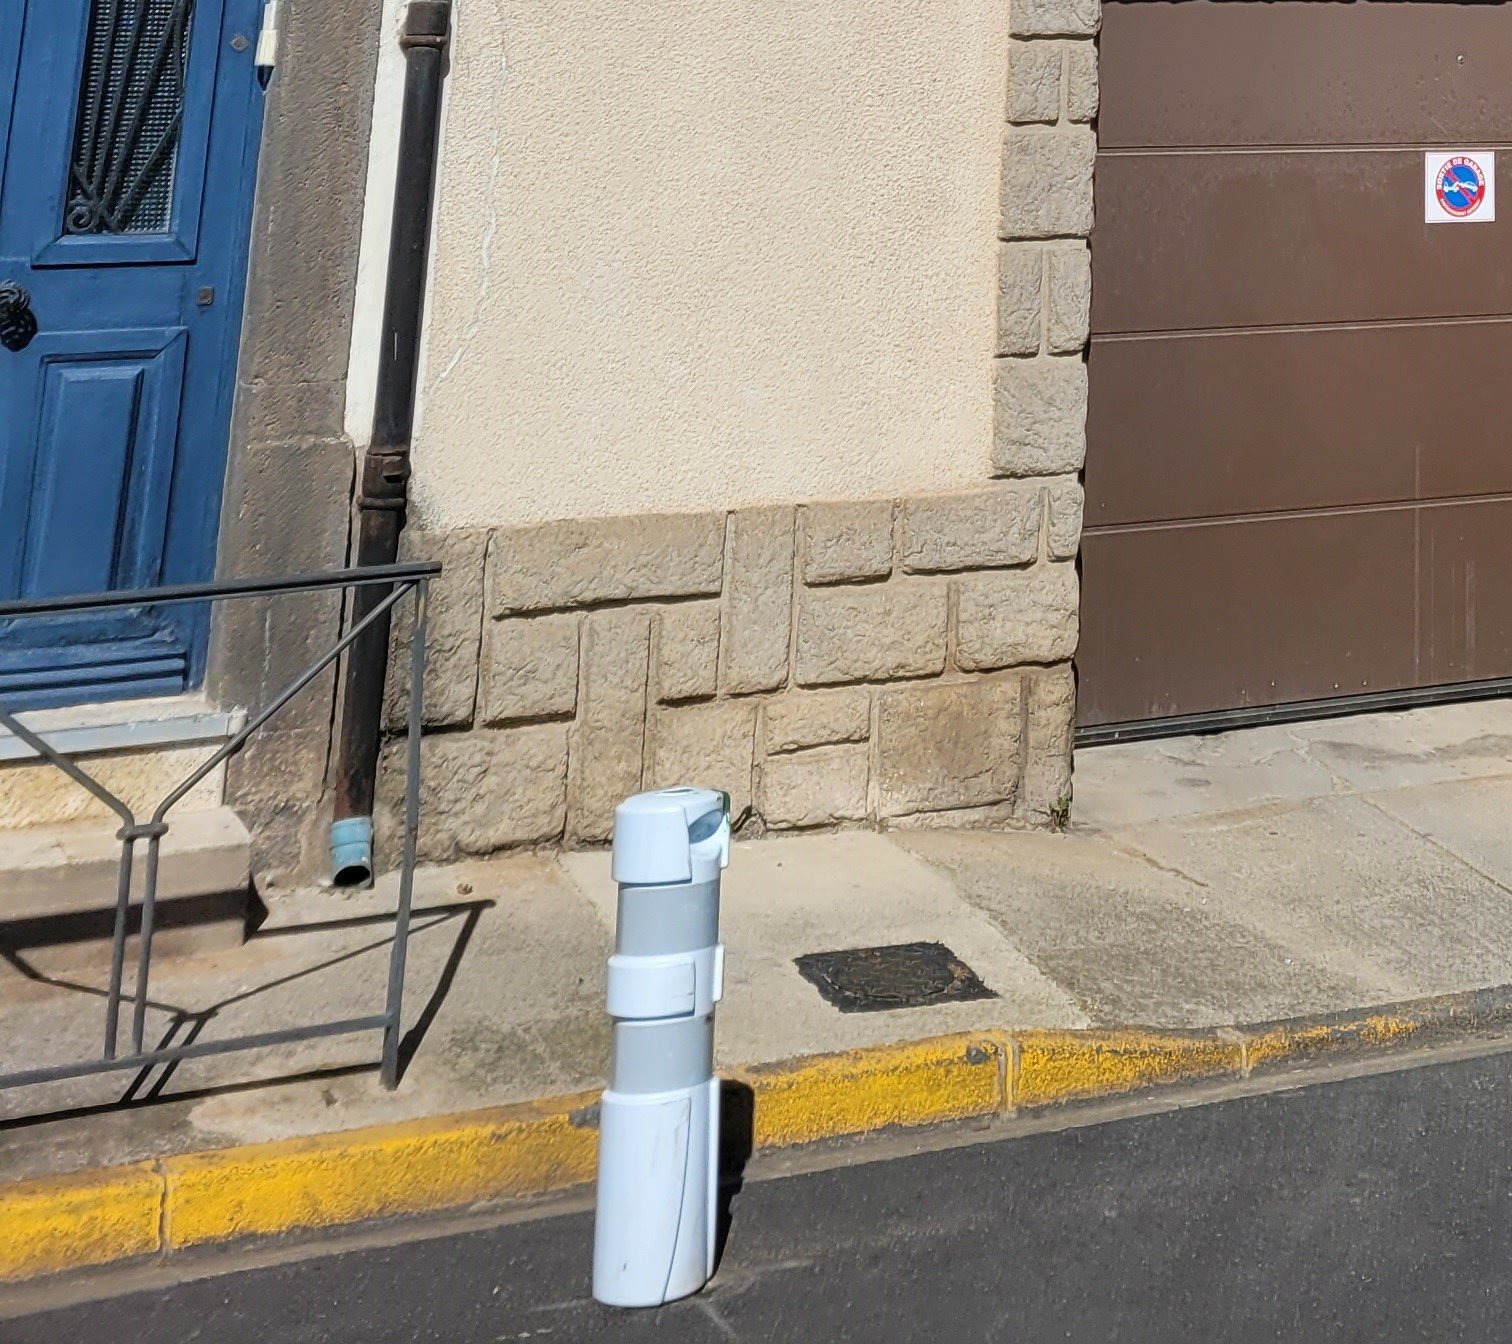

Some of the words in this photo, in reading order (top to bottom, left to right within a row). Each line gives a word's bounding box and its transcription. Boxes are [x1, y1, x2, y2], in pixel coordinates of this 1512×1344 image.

[1436, 161, 1453, 190] SORTIE
[1452, 157, 1463, 166] DE
[1463, 158, 1485, 187] GARAGE
